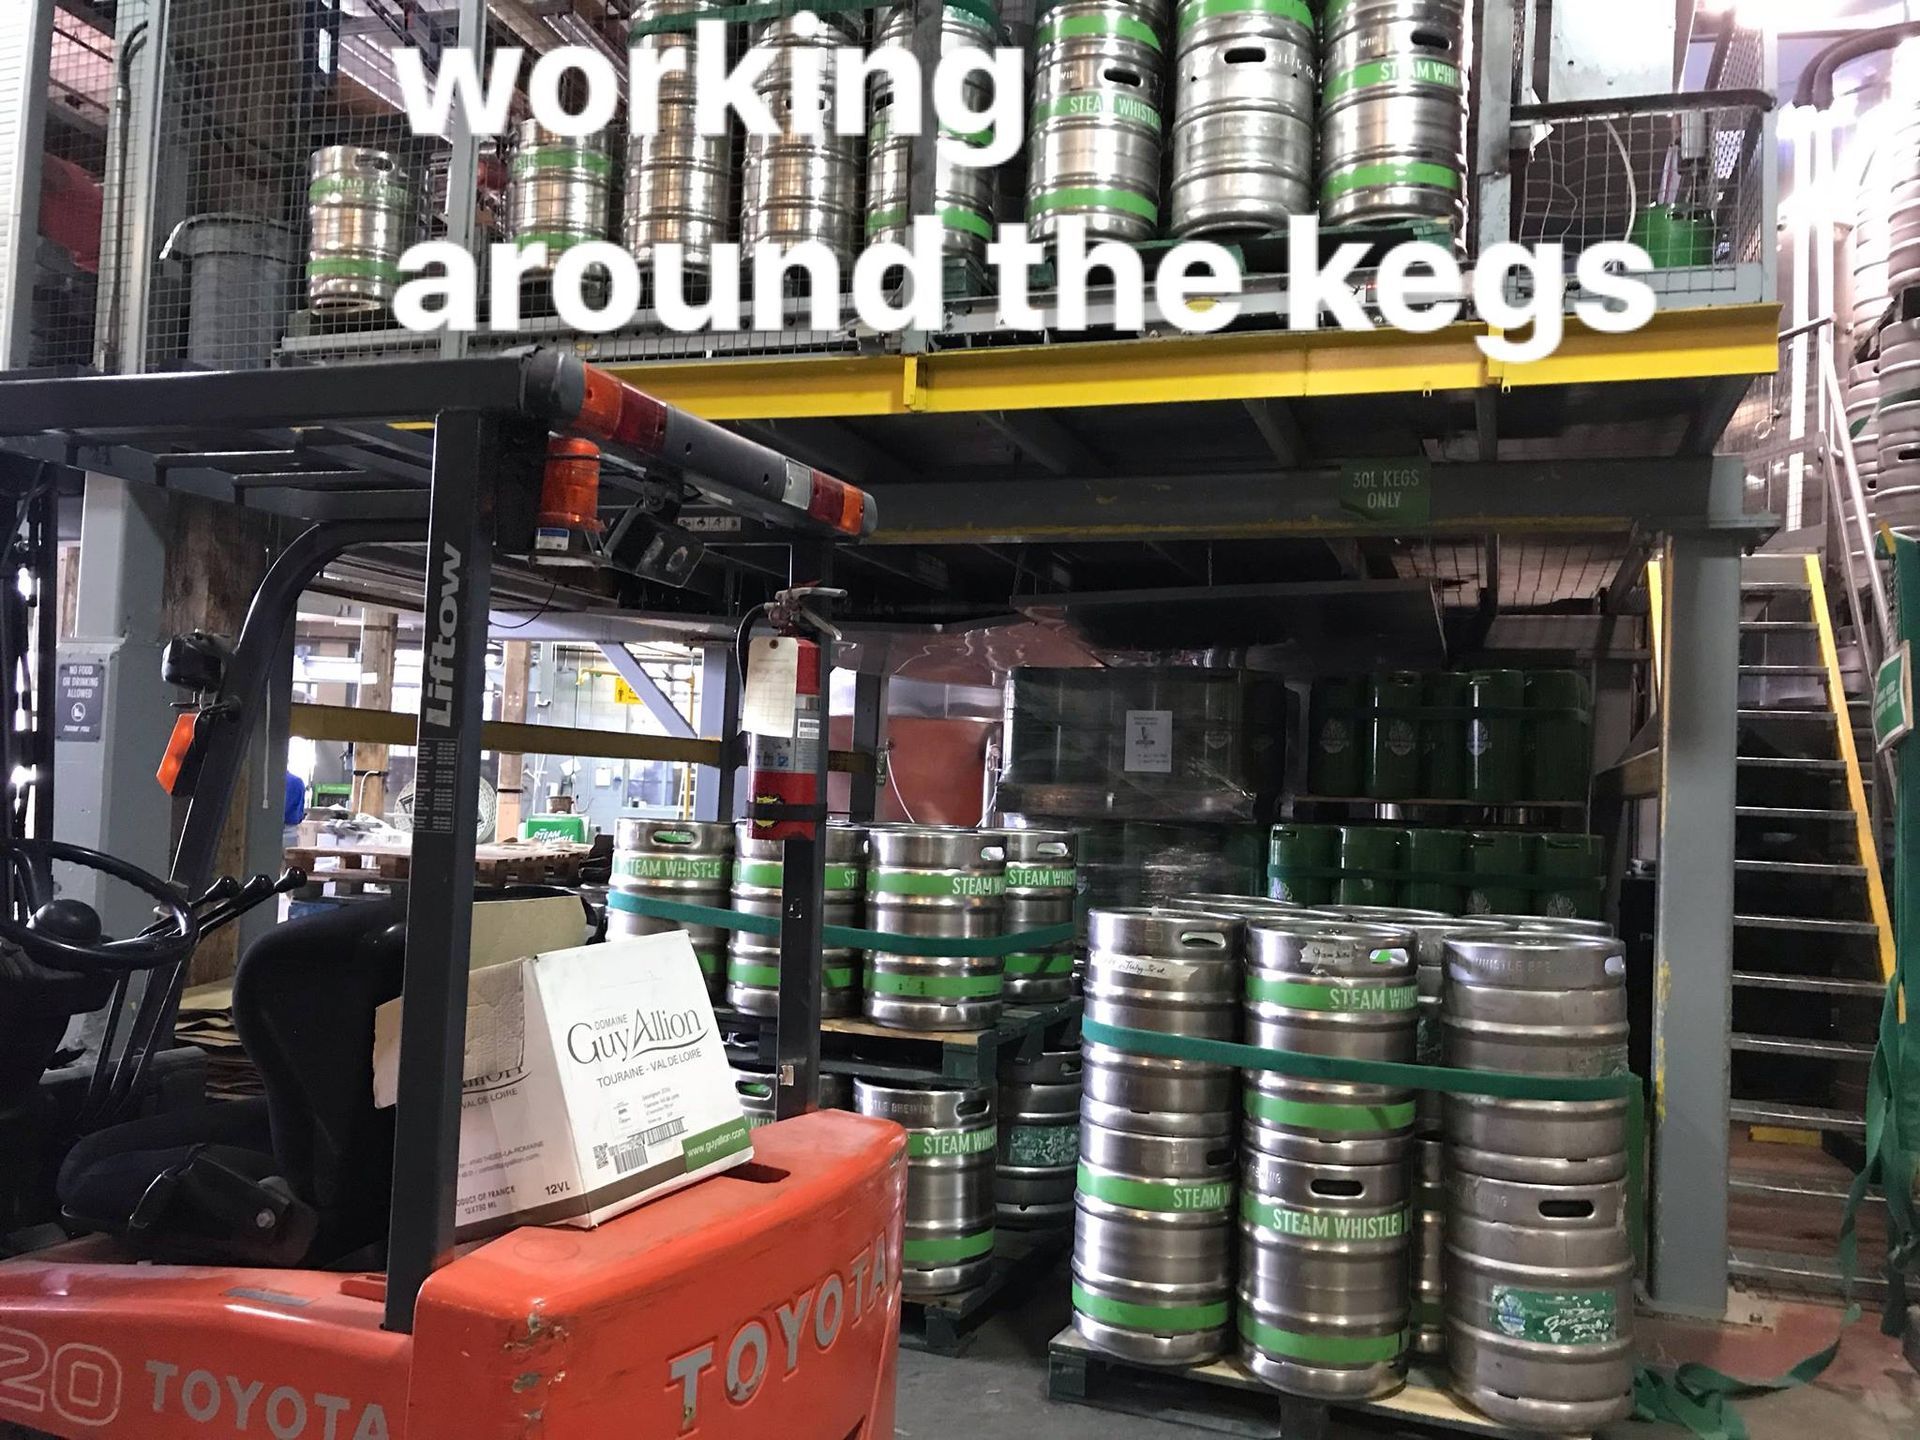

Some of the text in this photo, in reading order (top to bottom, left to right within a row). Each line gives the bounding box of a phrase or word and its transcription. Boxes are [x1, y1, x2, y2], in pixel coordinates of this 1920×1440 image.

[1380, 60, 1430, 81] STAM
[1352, 468, 1420, 489] 30L KEGS
[1367, 491, 1402, 509] ONLY
[425, 541, 462, 728] Liftow
[69, 665, 94, 676] NO FOOD
[67, 688, 93, 698] ALLOWED
[623, 860, 660, 877] STEAM
[664, 860, 721, 879] WHISTLE
[1008, 868, 1050, 886] STEAM
[952, 876, 993, 895] STEAM
[1329, 987, 1386, 1011] STEAM
[594, 1013, 629, 1031] DOMAINE
[567, 1008, 702, 1065] Guy Allion
[596, 1065, 646, 1089] TOURAINE
[650, 1058, 668, 1073] VAL
[667, 1054, 680, 1068] DE
[680, 1048, 703, 1064] LOIRE
[490, 1087, 519, 1102] LOIRE
[923, 1133, 970, 1155] STEAM
[488, 1185, 516, 1198] FRANCE
[1173, 1184, 1221, 1209] STEAM
[1273, 1208, 1398, 1239] STEAM WHISTLE
[666, 1230, 888, 1440] TOYOTA
[145, 1360, 391, 1440] TOYOTA
